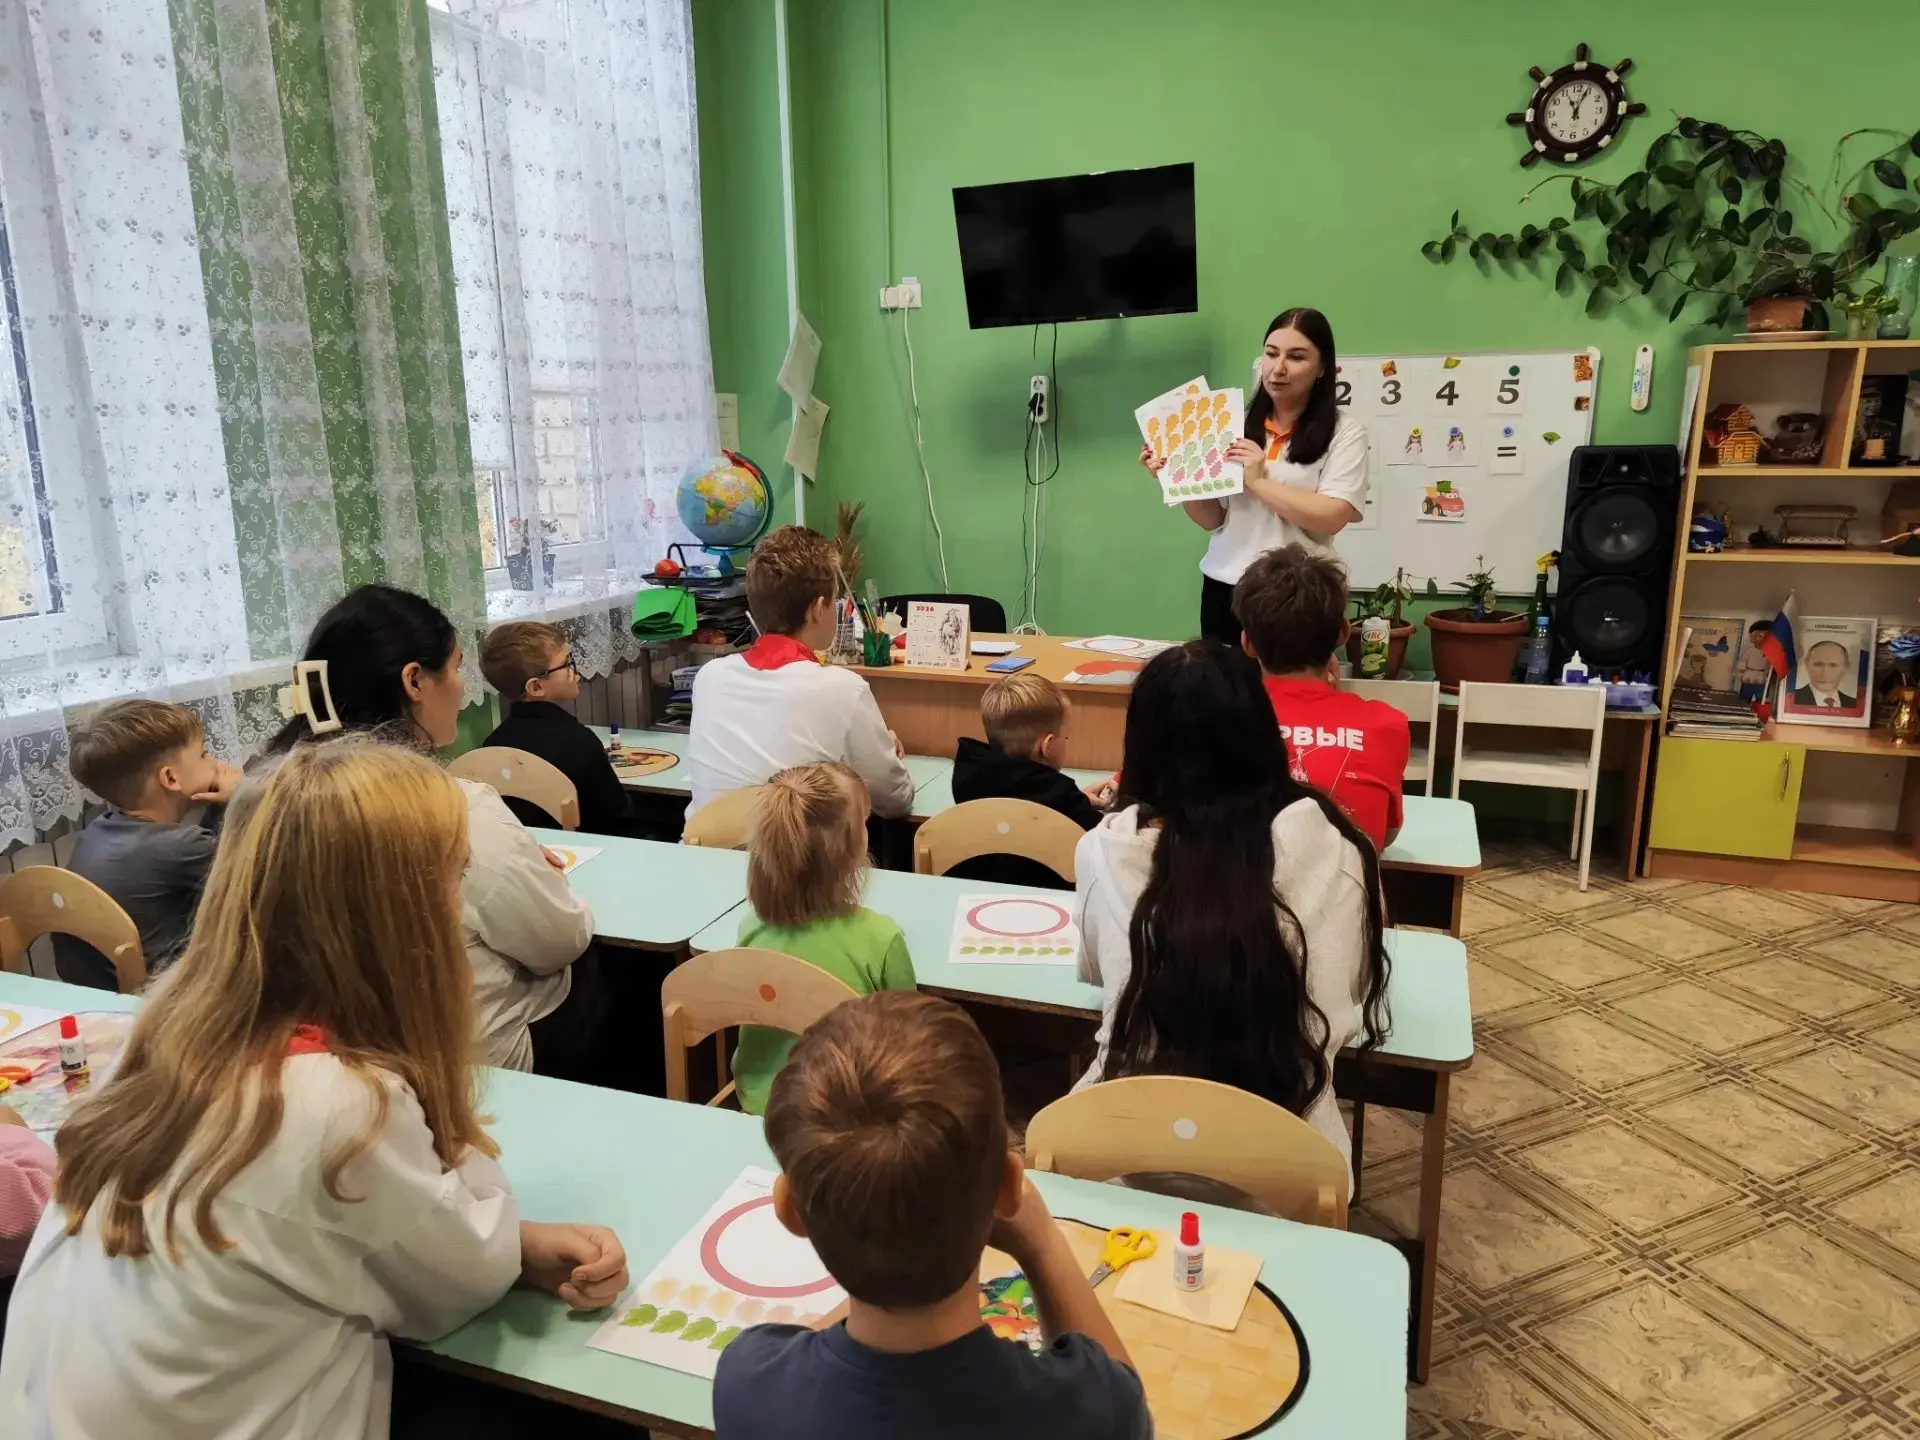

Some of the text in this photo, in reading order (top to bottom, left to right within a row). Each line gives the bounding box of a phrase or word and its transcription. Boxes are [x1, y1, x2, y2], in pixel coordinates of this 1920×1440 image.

[1573, 84, 1583, 93] 12
[1561, 89, 1569, 97] 11
[1593, 95, 1601, 103] 2
[1548, 110, 1556, 118] 9
[1595, 106, 1603, 114] 3
[1559, 130, 1565, 138] 7
[1569, 131, 1577, 140] 6
[1582, 127, 1589, 136] 5
[1335, 378, 1520, 406] 2 3 4 5
